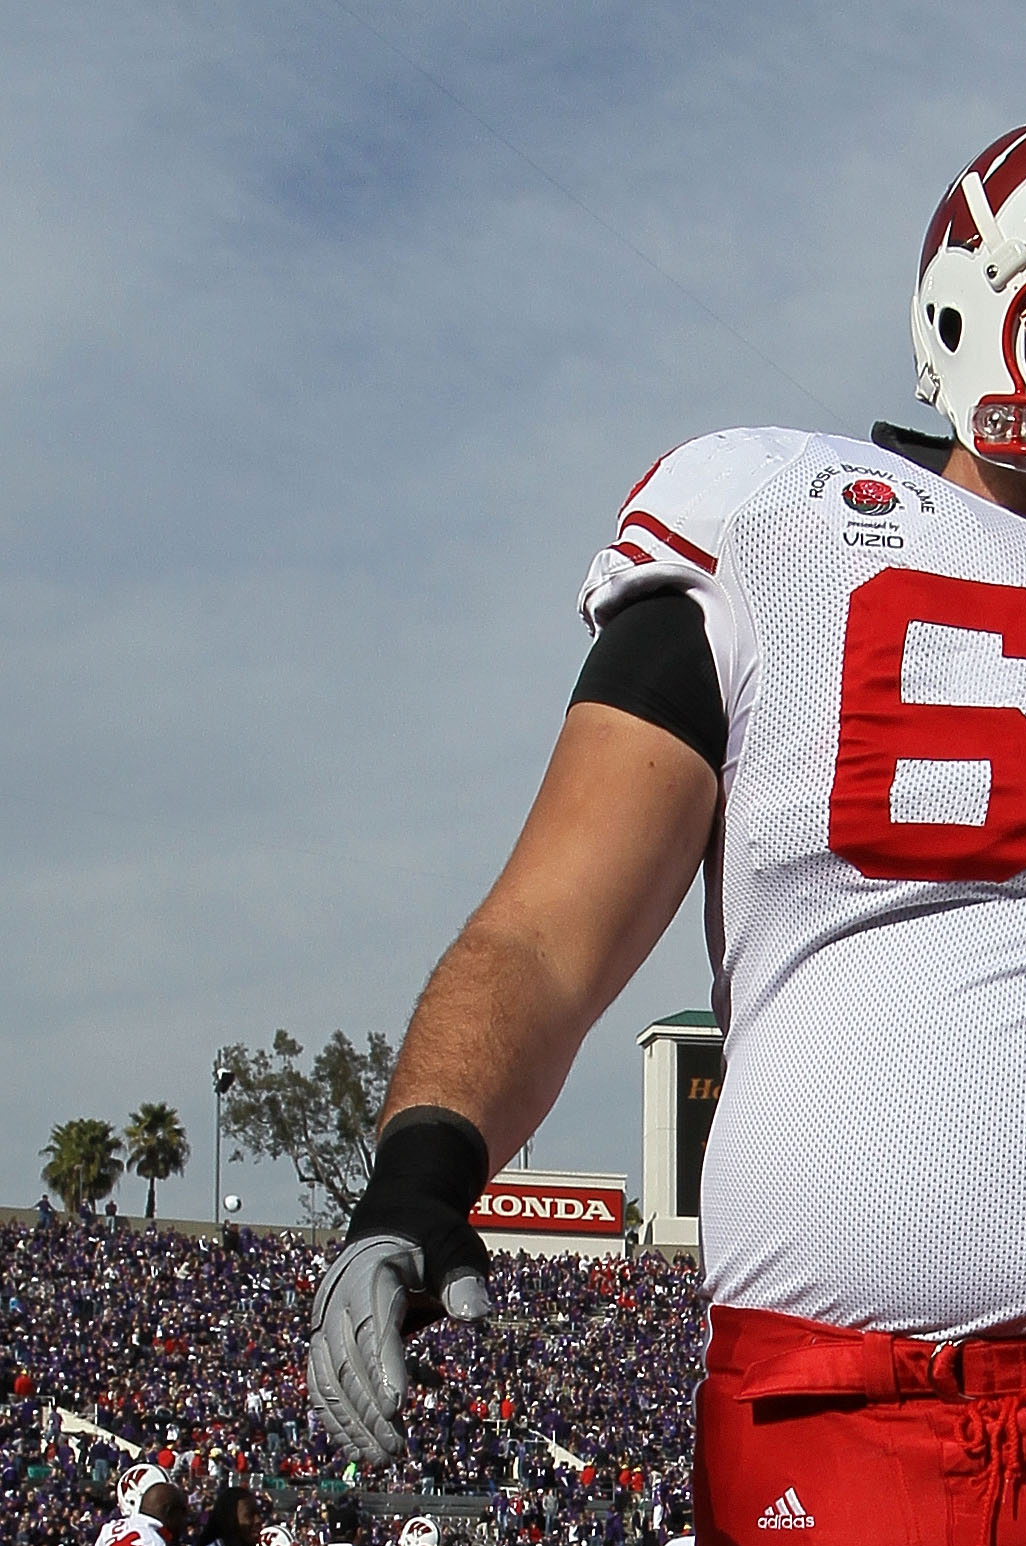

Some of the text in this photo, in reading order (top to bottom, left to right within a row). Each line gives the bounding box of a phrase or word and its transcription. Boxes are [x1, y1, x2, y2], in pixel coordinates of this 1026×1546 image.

[809, 463, 935, 514] ROSE BOWL GAME
[889, 521, 899, 532] by
[843, 532, 904, 549] VIZIO
[469, 1194, 616, 1222] HONDA
[757, 1514, 815, 1530] adidas
